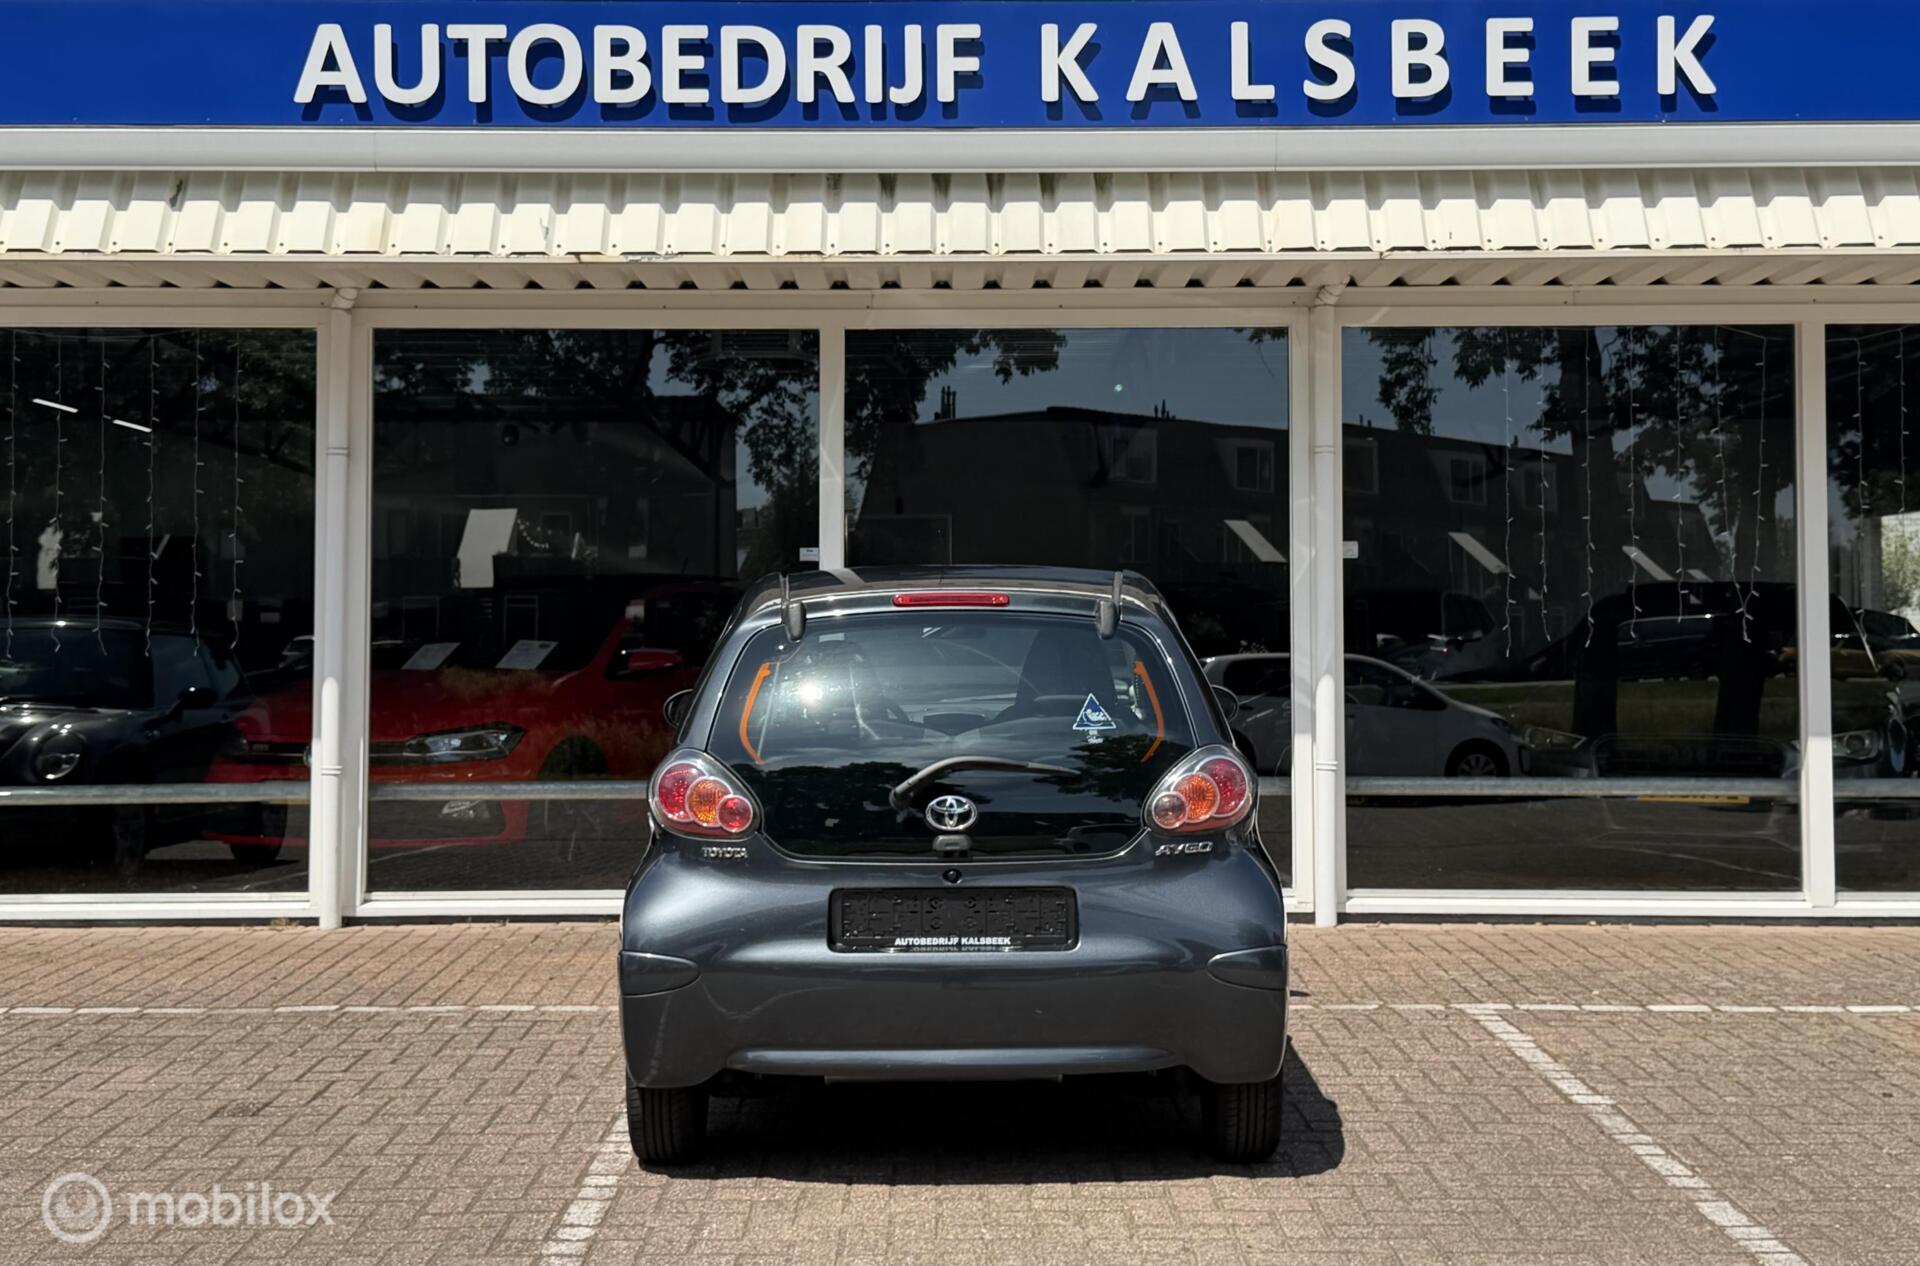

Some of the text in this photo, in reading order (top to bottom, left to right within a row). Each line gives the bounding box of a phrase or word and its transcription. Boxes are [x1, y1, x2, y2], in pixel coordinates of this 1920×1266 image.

[293, 15, 1718, 104] AUTOBEDRIJF KALSBEEK
[701, 846, 748, 858] TOYOTA
[1155, 841, 1213, 856] AYGO
[894, 936, 1012, 946] AUTOBEDRIJF KALSBEEK
